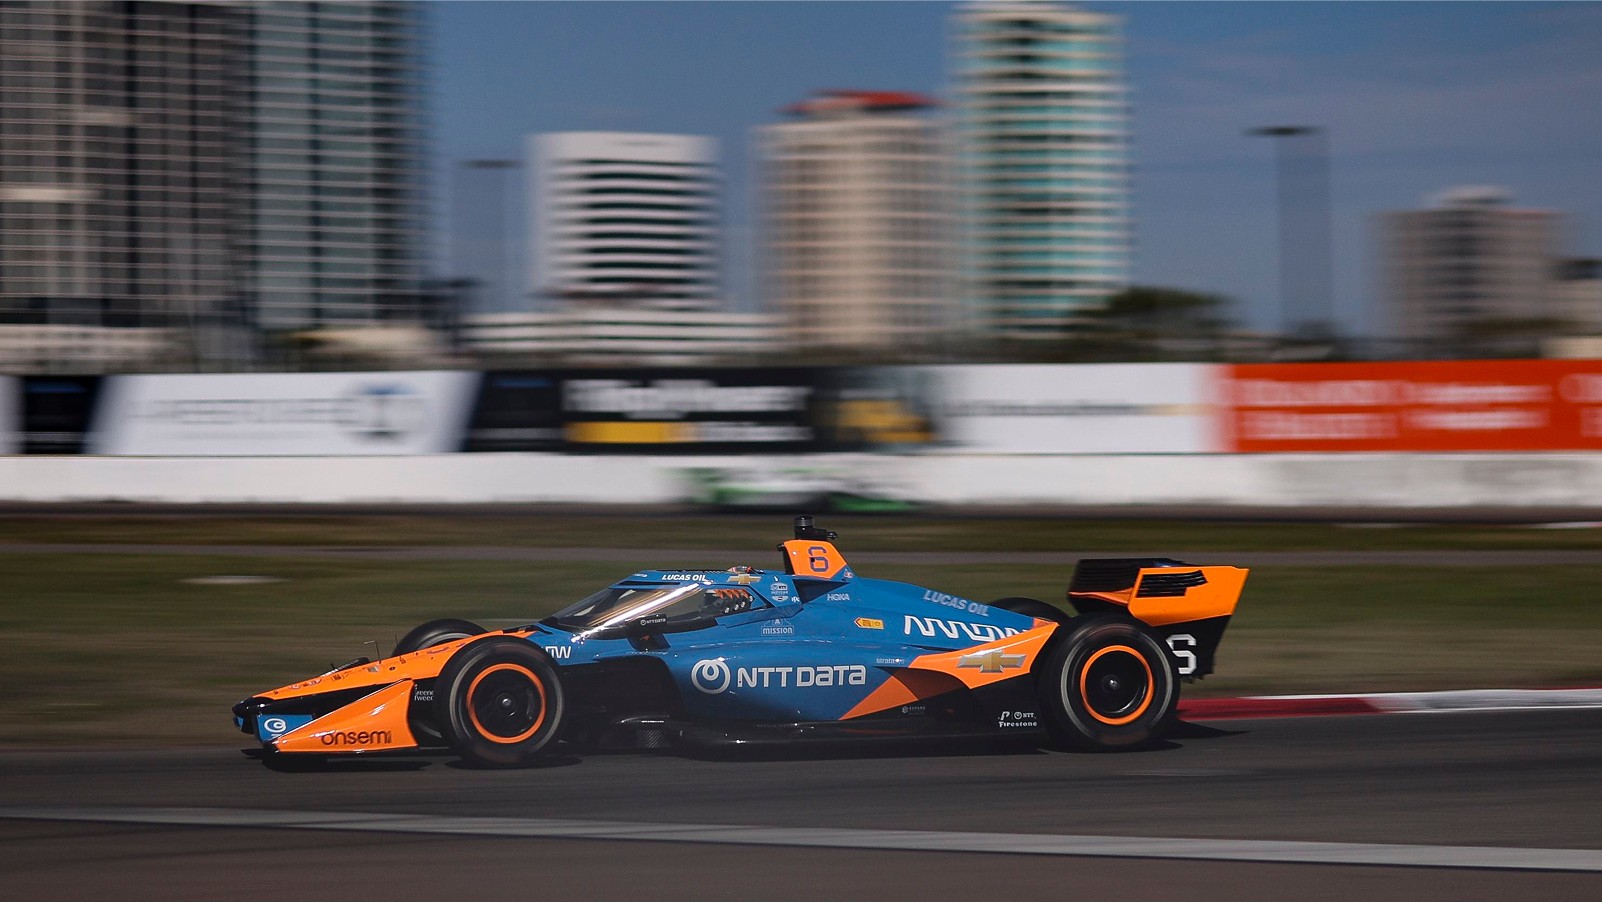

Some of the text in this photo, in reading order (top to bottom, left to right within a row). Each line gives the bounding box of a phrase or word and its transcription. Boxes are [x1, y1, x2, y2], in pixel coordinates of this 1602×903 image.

[808, 546, 829, 572] 6
[922, 589, 990, 617] LUCAS OIL
[737, 667, 793, 688] NTT
[320, 730, 392, 746] onsemi
